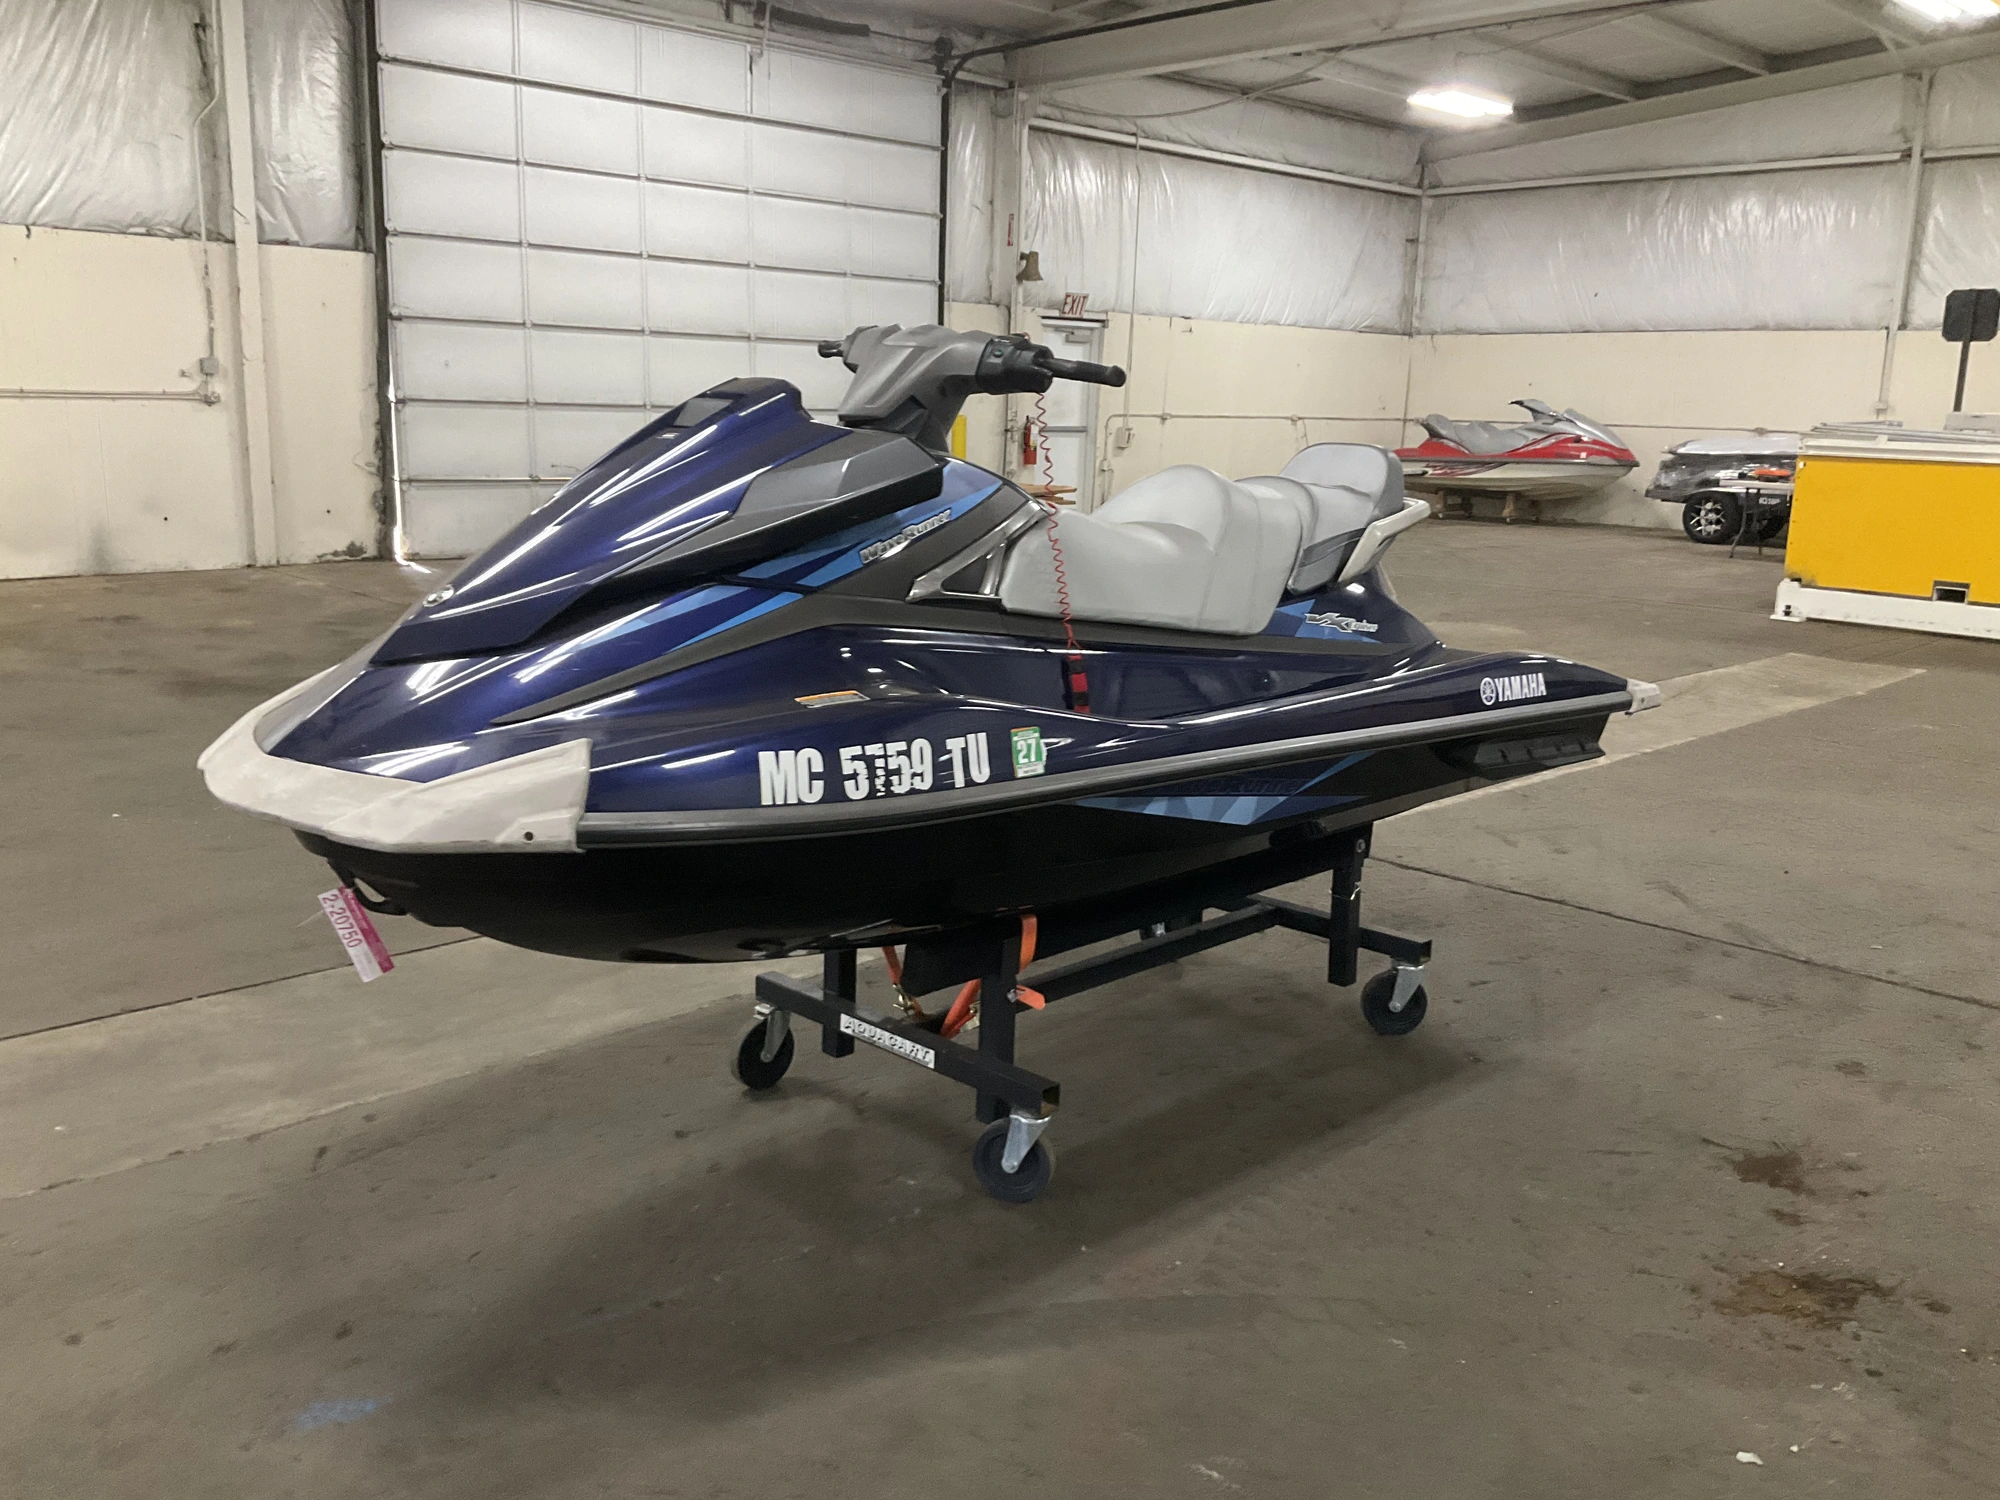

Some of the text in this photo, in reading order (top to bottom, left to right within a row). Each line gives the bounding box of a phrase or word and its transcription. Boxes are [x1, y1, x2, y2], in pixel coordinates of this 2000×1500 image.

[1061, 294, 1088, 315] EXIT
[1494, 672, 1547, 702] YAMAHA
[758, 747, 825, 806] MC
[945, 732, 991, 788] TU
[1017, 738, 1036, 764] 27
[322, 893, 363, 949] 2-20750
[844, 1018, 931, 1060] AQUACART
